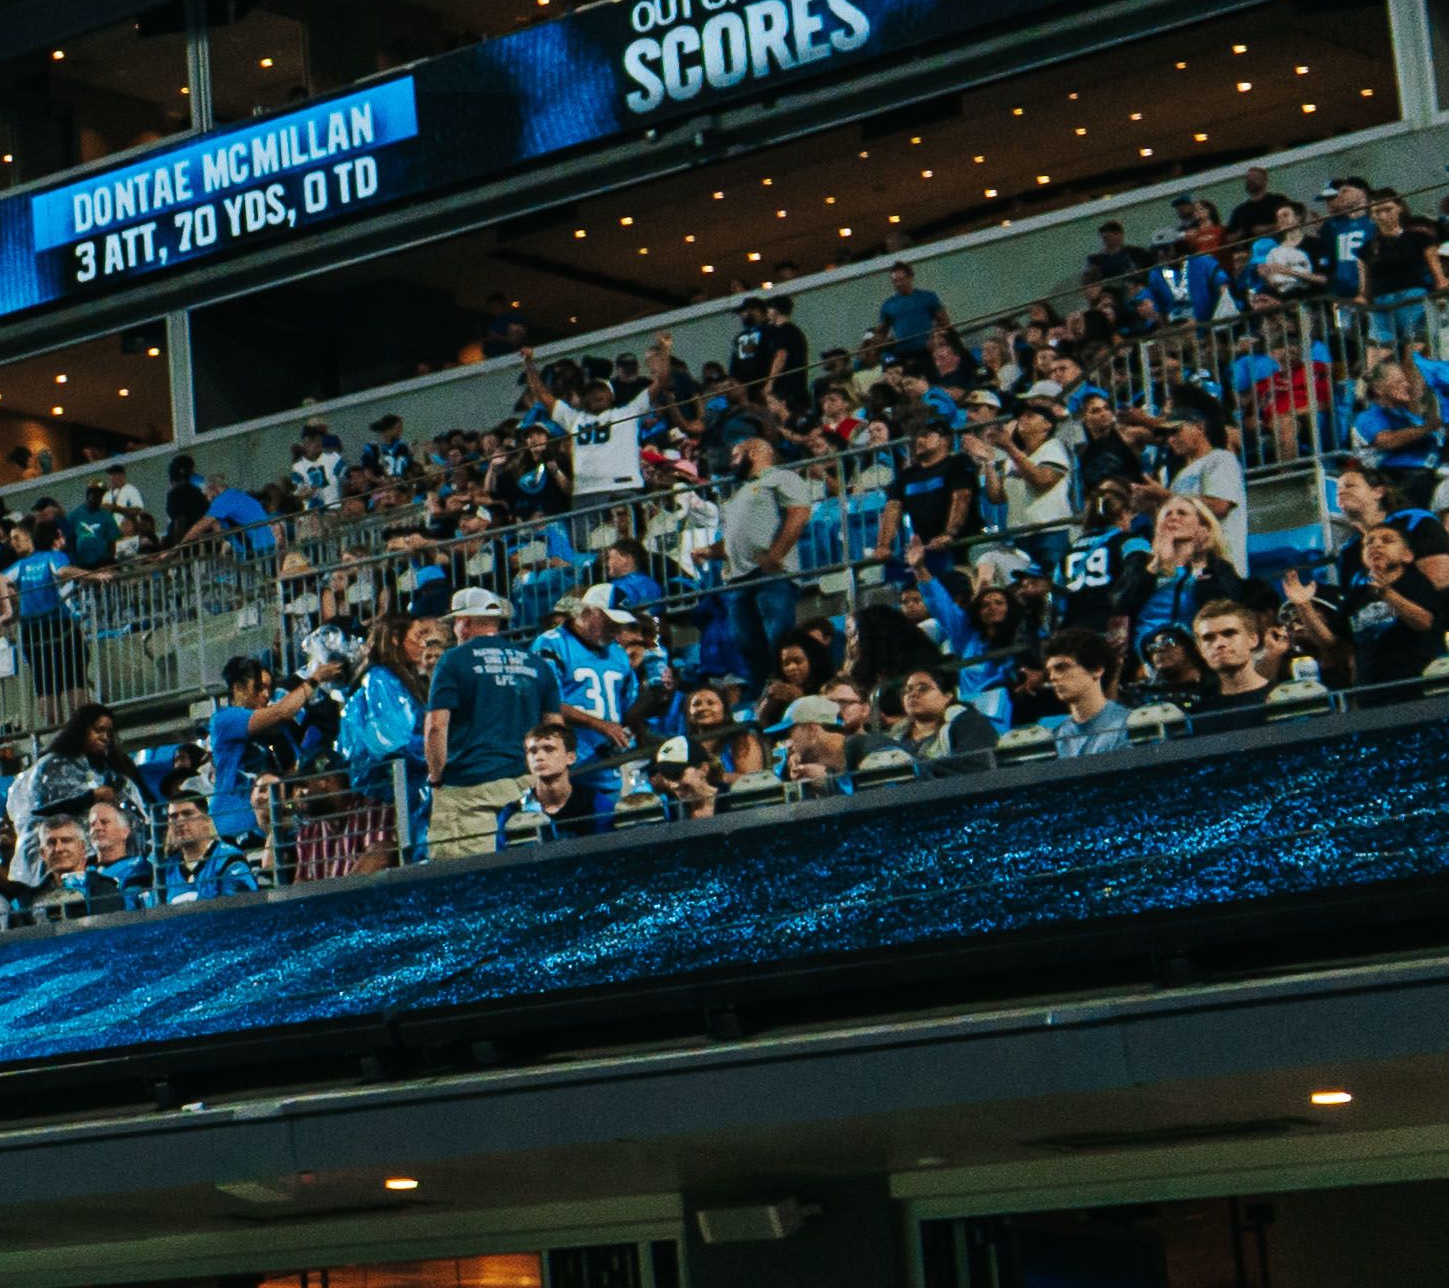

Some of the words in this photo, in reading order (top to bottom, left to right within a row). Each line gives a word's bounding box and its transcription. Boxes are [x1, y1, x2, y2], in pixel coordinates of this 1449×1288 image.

[74, 161, 193, 233] DONTAE
[204, 102, 374, 193] MCMILLAN
[75, 241, 96, 283] 3
[104, 222, 168, 274] ATT,
[175, 204, 217, 253] 70
[224, 183, 296, 237] YDS,
[303, 170, 327, 214] 0
[334, 156, 378, 205] TD
